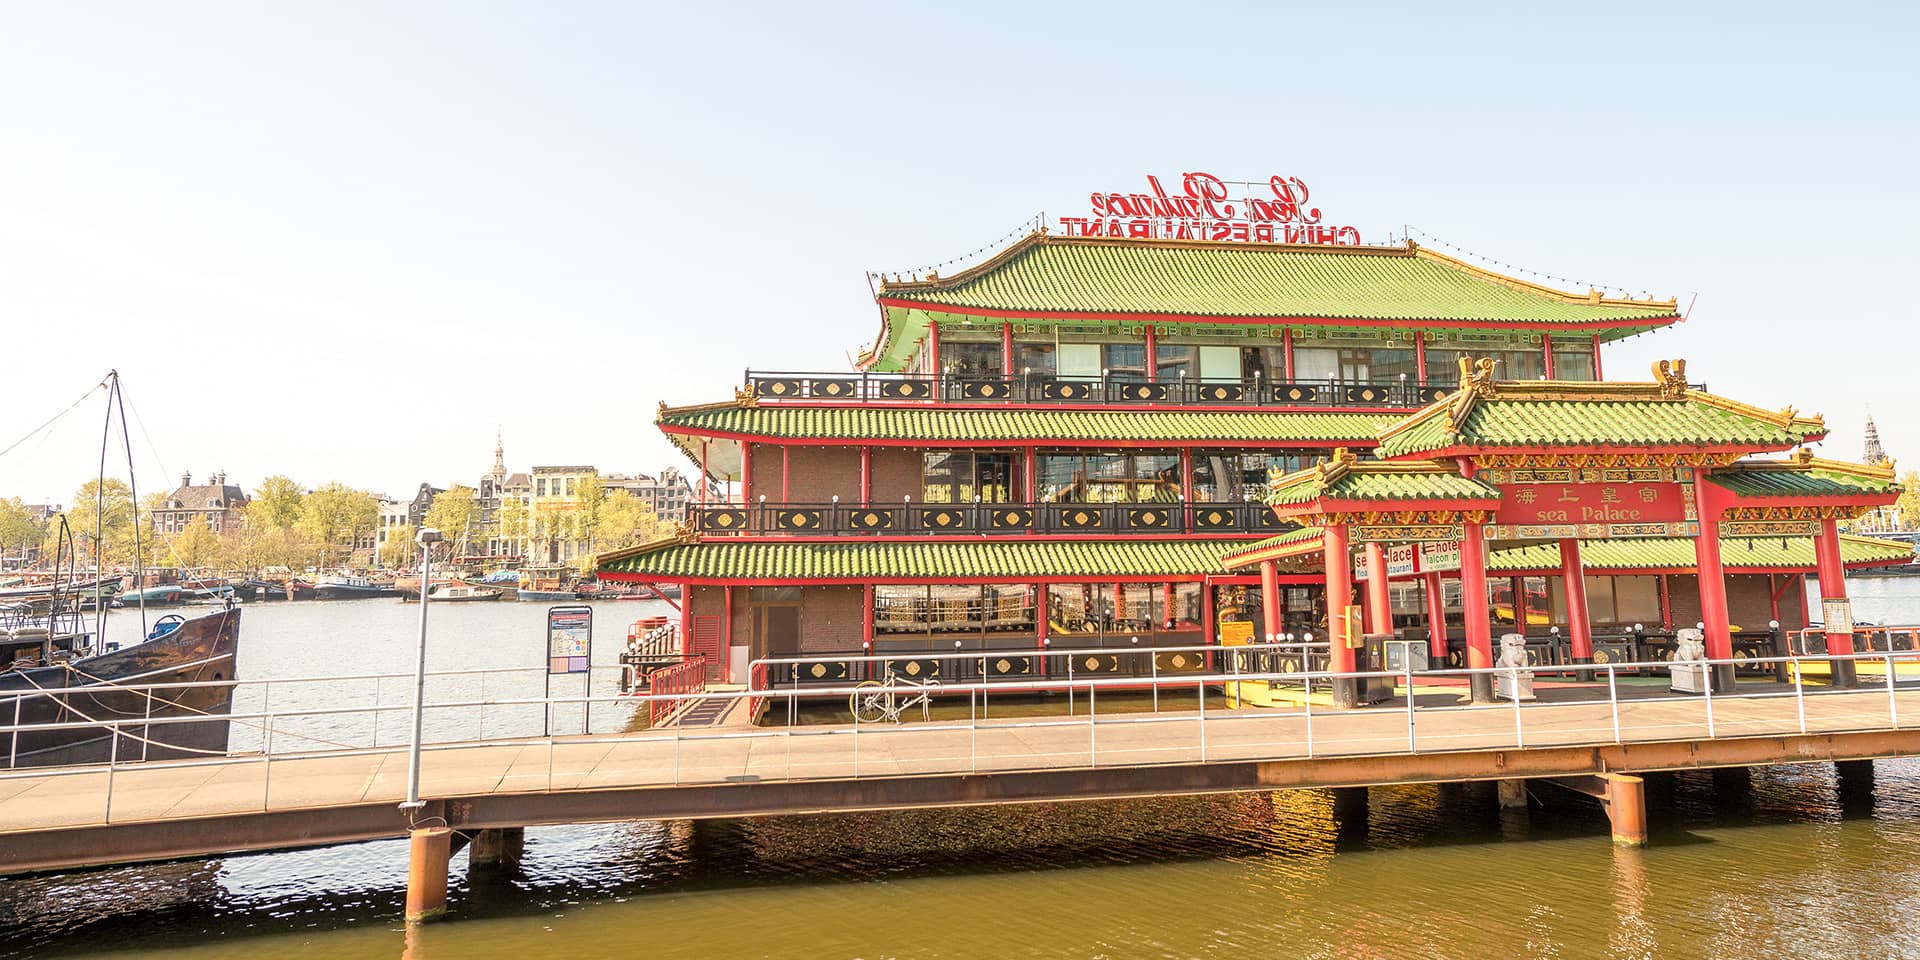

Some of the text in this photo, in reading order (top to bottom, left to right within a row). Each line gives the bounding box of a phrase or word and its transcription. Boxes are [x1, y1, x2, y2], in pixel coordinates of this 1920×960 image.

[1537, 504, 1641, 522] sea Palace
[1436, 541, 1458, 553] hote
[1356, 548, 1412, 568] se lace
